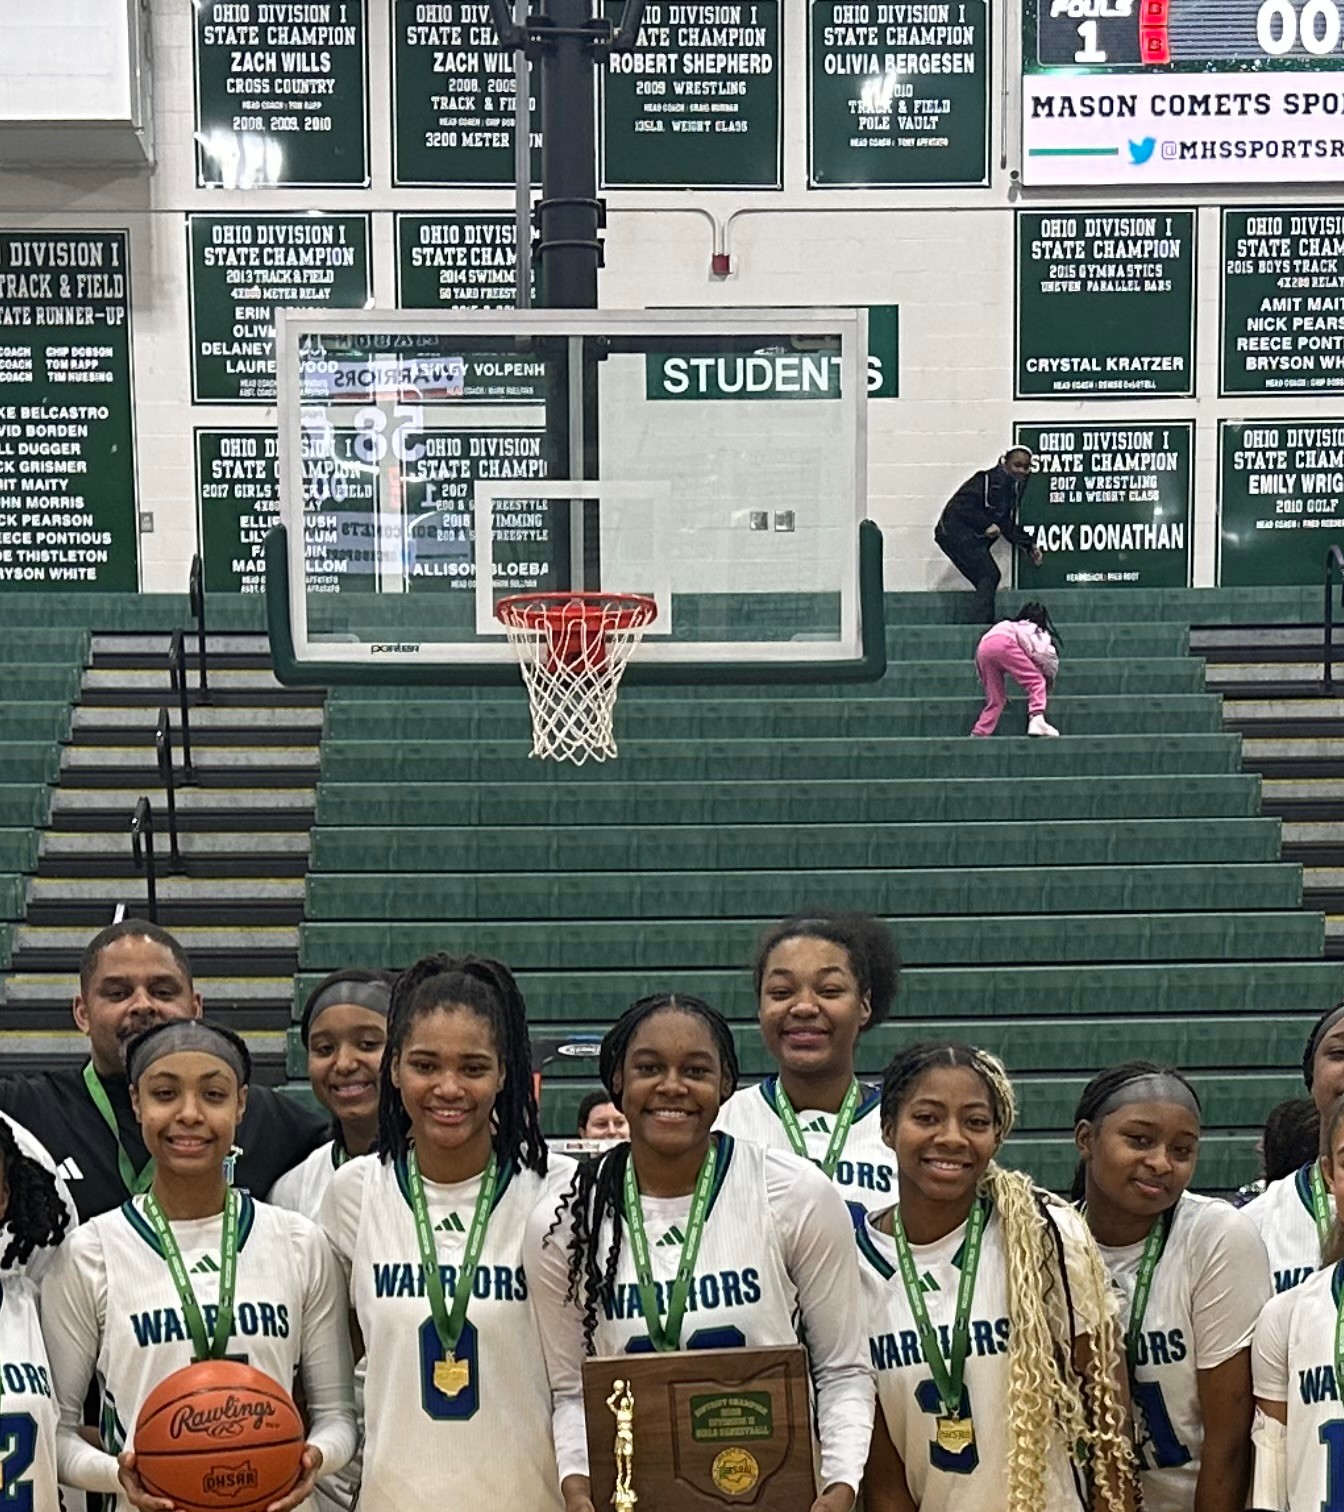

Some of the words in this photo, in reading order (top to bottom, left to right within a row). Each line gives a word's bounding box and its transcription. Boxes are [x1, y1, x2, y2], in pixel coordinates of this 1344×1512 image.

[213, 4, 249, 22] OHIO
[258, 4, 330, 23] DIVISION
[340, 5, 346, 23] I
[205, 26, 259, 45] STATE
[268, 26, 355, 45] CHAMPION
[1074, 21, 1106, 63] 1
[231, 51, 276, 72] ZACH
[281, 52, 330, 72] WILLS
[610, 53, 678, 73] ROBERT
[683, 53, 772, 74] SHEPHERD
[825, 54, 879, 74] OLIVIA
[883, 53, 974, 74] BERGESEN
[227, 78, 270, 93] CROSS
[275, 79, 335, 94] COUNTRY
[673, 81, 746, 95] WRESTLING
[1032, 95, 1137, 118] MASON
[1151, 94, 1270, 116] COMETS
[859, 116, 890, 130] POLE
[898, 116, 938, 129] VAULT
[1041, 219, 1076, 237] OHIO
[1085, 218, 1156, 237] DIVISION
[1166, 218, 1172, 236] I
[10, 242, 103, 266] DIVISION
[111, 242, 119, 266] I
[1032, 241, 1085, 259] STATE
[1094, 240, 1180, 258] CHAMPION
[1050, 265, 1076, 278] 2015
[1079, 264, 1162, 278] GYMNASTICS
[60, 274, 71, 298] &
[77, 274, 126, 299] FIELD
[1261, 298, 1302, 311] AMIT
[36, 306, 126, 325] RUNNER-UP
[1237, 337, 1292, 350] REECE
[1026, 358, 1101, 372] CRYSTAL
[1107, 357, 1183, 370] KRATZER
[21, 407, 109, 419] BELCASTRO
[1249, 474, 1296, 494] EMILY
[1276, 499, 1303, 513] 2010
[1307, 499, 1338, 512] GOLF
[22, 514, 93, 526] PEARSON
[1080, 523, 1184, 551] DONATHAN
[130, 1302, 289, 1348] WARORS
[170, 1394, 276, 1439] Rawlings
